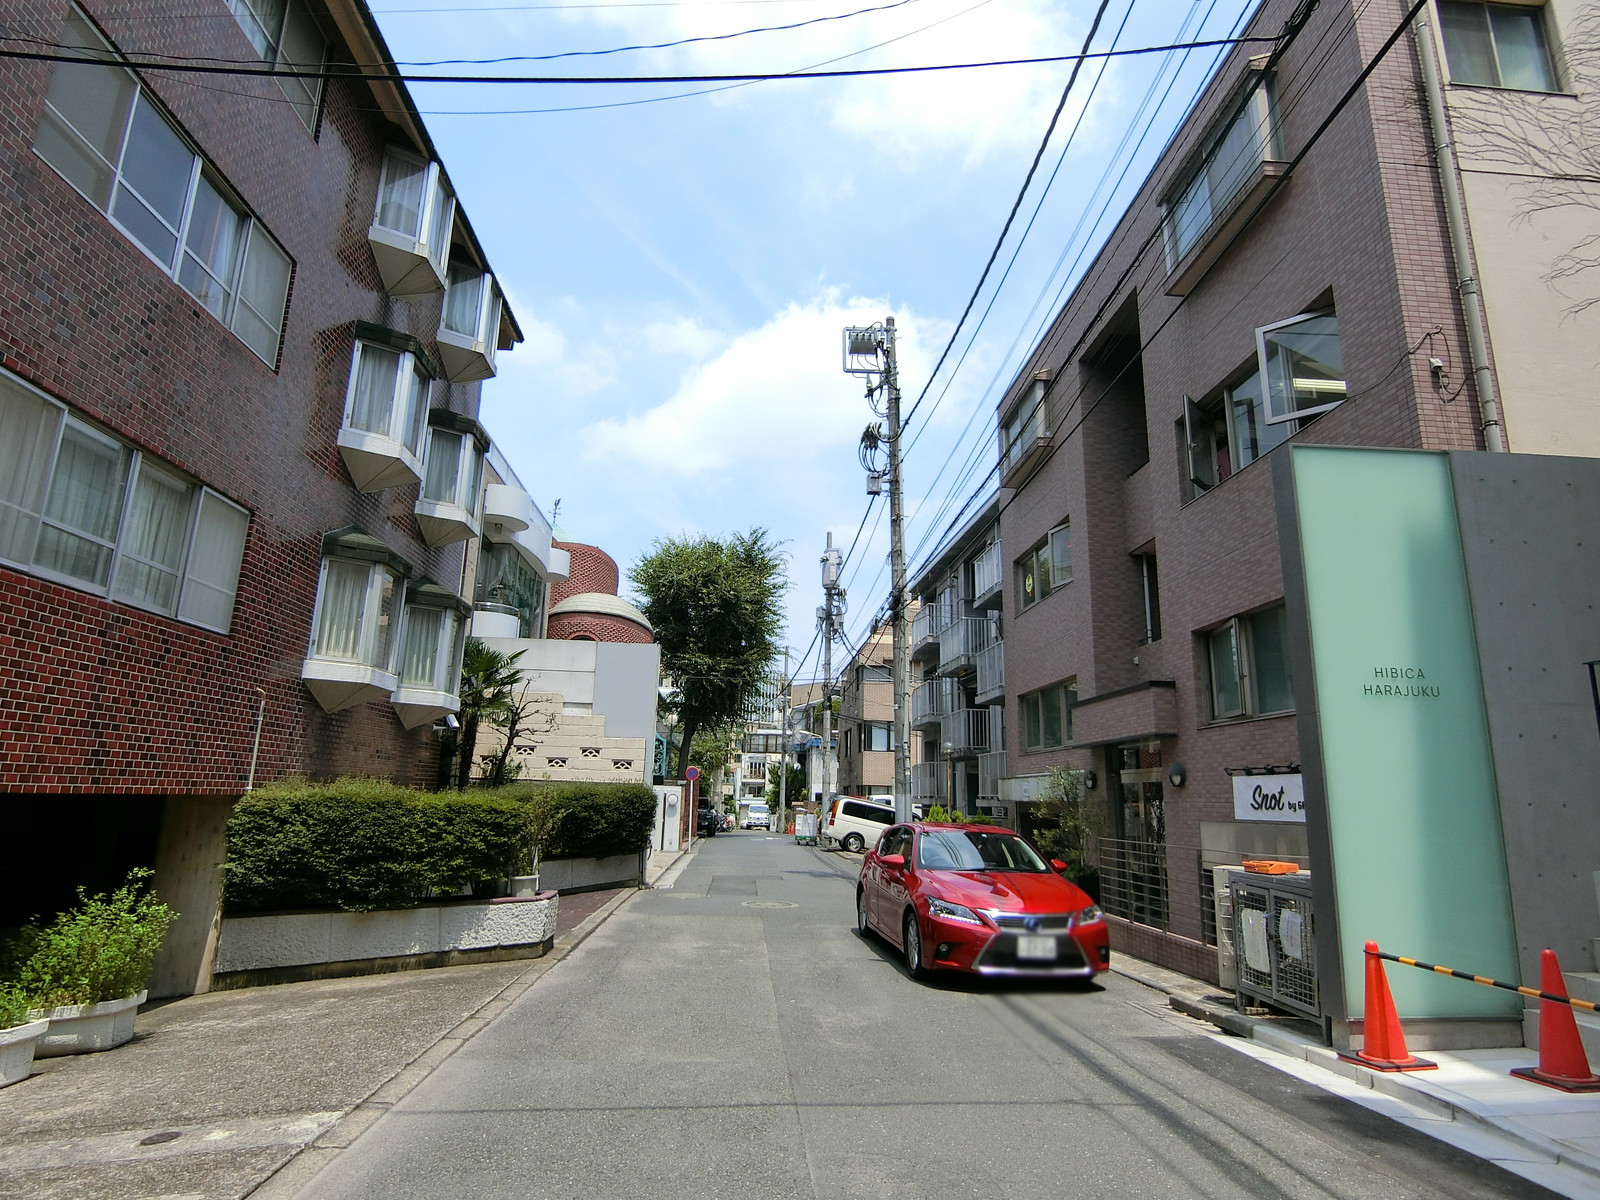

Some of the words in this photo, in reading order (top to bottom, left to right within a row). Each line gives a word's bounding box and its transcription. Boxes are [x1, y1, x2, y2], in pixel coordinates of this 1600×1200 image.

[1374, 667, 1425, 679] HIBICA
[1363, 684, 1440, 698] HARAJUKU
[1250, 784, 1285, 811] Snot
[1288, 801, 1297, 813] by
